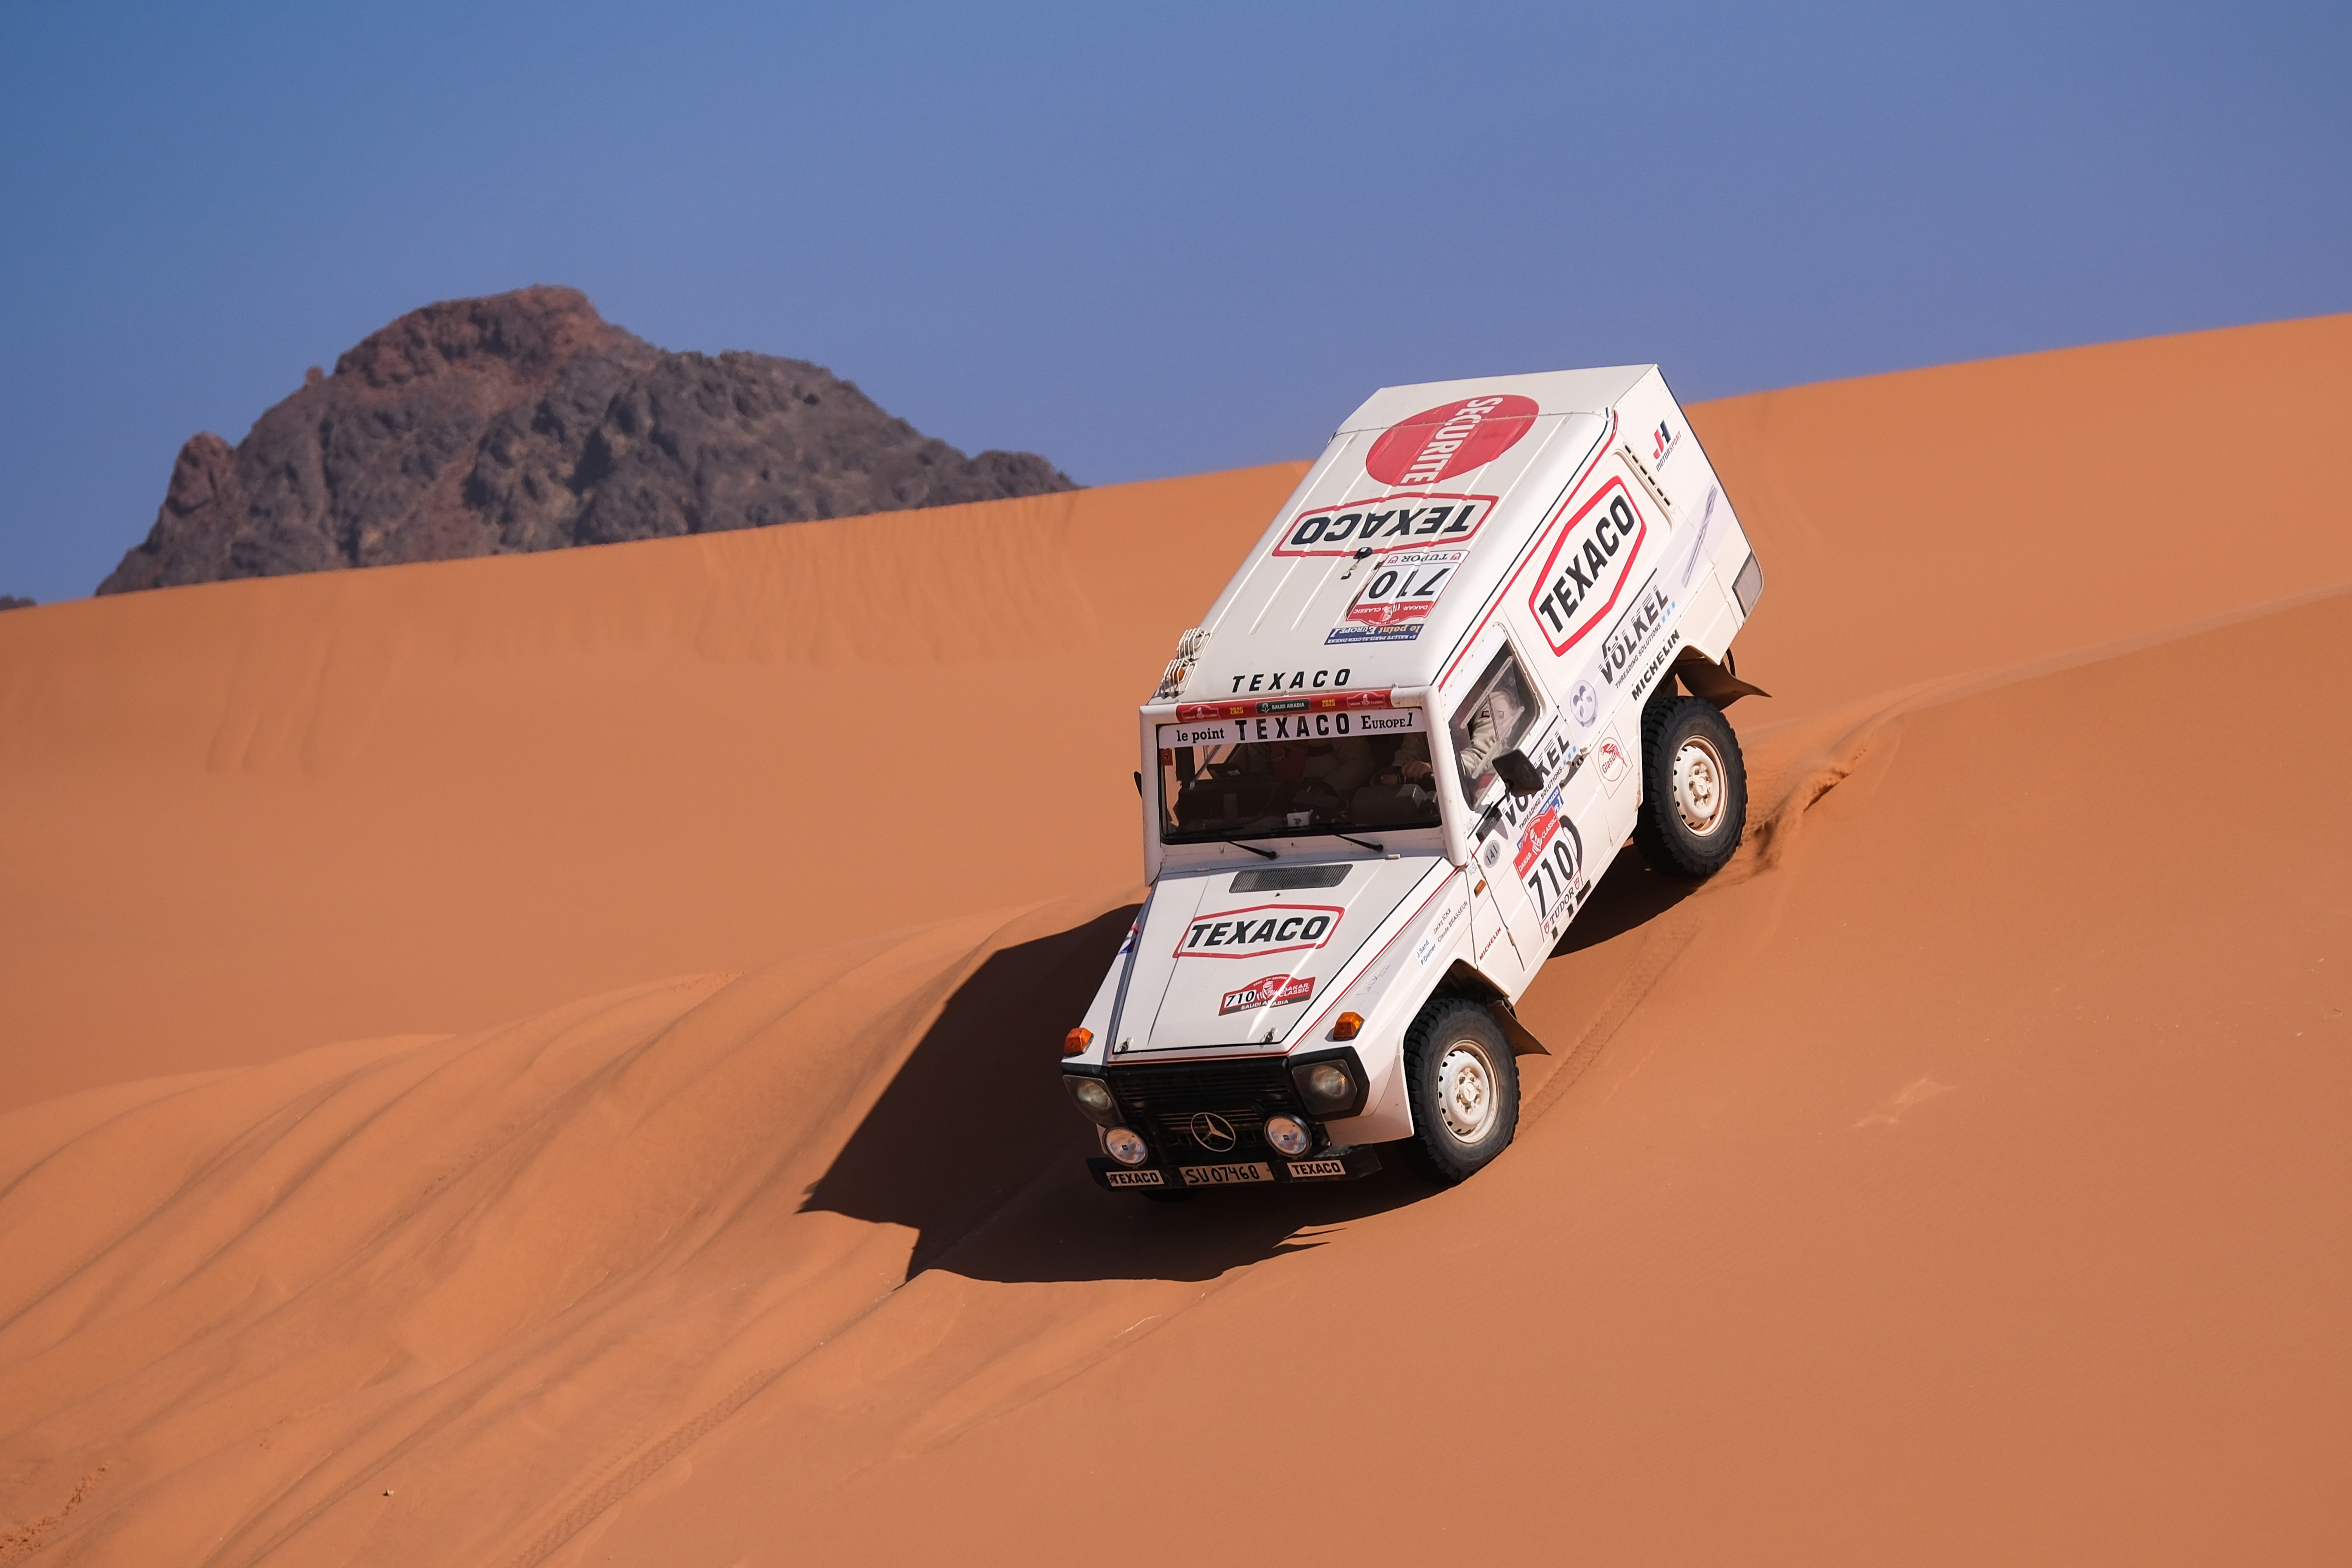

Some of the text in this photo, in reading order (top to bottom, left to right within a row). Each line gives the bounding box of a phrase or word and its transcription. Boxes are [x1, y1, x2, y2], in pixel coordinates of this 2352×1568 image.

[1402, 397, 1503, 483] SECURITE
[1656, 430, 1681, 472] MOTORSPORT
[1290, 504, 1476, 545] TEXACO
[1539, 495, 1634, 633] TEXACO
[1368, 568, 1451, 599] 710
[1352, 605, 1381, 614] CLASSIC
[1378, 624, 1409, 634] point
[1615, 622, 1661, 688] THREADING SOLUTIONS
[1631, 629, 1680, 701] MICHELIN
[1232, 668, 1351, 693] TEXACO
[1176, 728, 1225, 743] le point
[1235, 713, 1350, 740] TEXACO
[1602, 749, 1618, 773] Glasur
[1519, 799, 1541, 830] THREADING
[1541, 767, 1563, 799] SOLUTIONS
[1486, 845, 1498, 864] 141
[1518, 851, 1532, 873] DAKAR
[1541, 816, 1557, 838] CLASSIC
[1529, 840, 1573, 920] 710
[1434, 907, 1452, 935] Jacky ICKX
[1437, 900, 1468, 942] Claude BRASSEUR
[1549, 887, 1575, 925] TUDOR
[1187, 916, 1330, 948] TEXACO
[1479, 927, 1502, 961] MICHELIN
[1226, 991, 1254, 1007] 710
[1241, 1001, 1261, 1010] SAUDI
[1279, 983, 1310, 997] DAKAR CLASSIC
[1110, 1172, 1160, 1184] TEXACO
[1291, 1162, 1341, 1175] TEXACO
